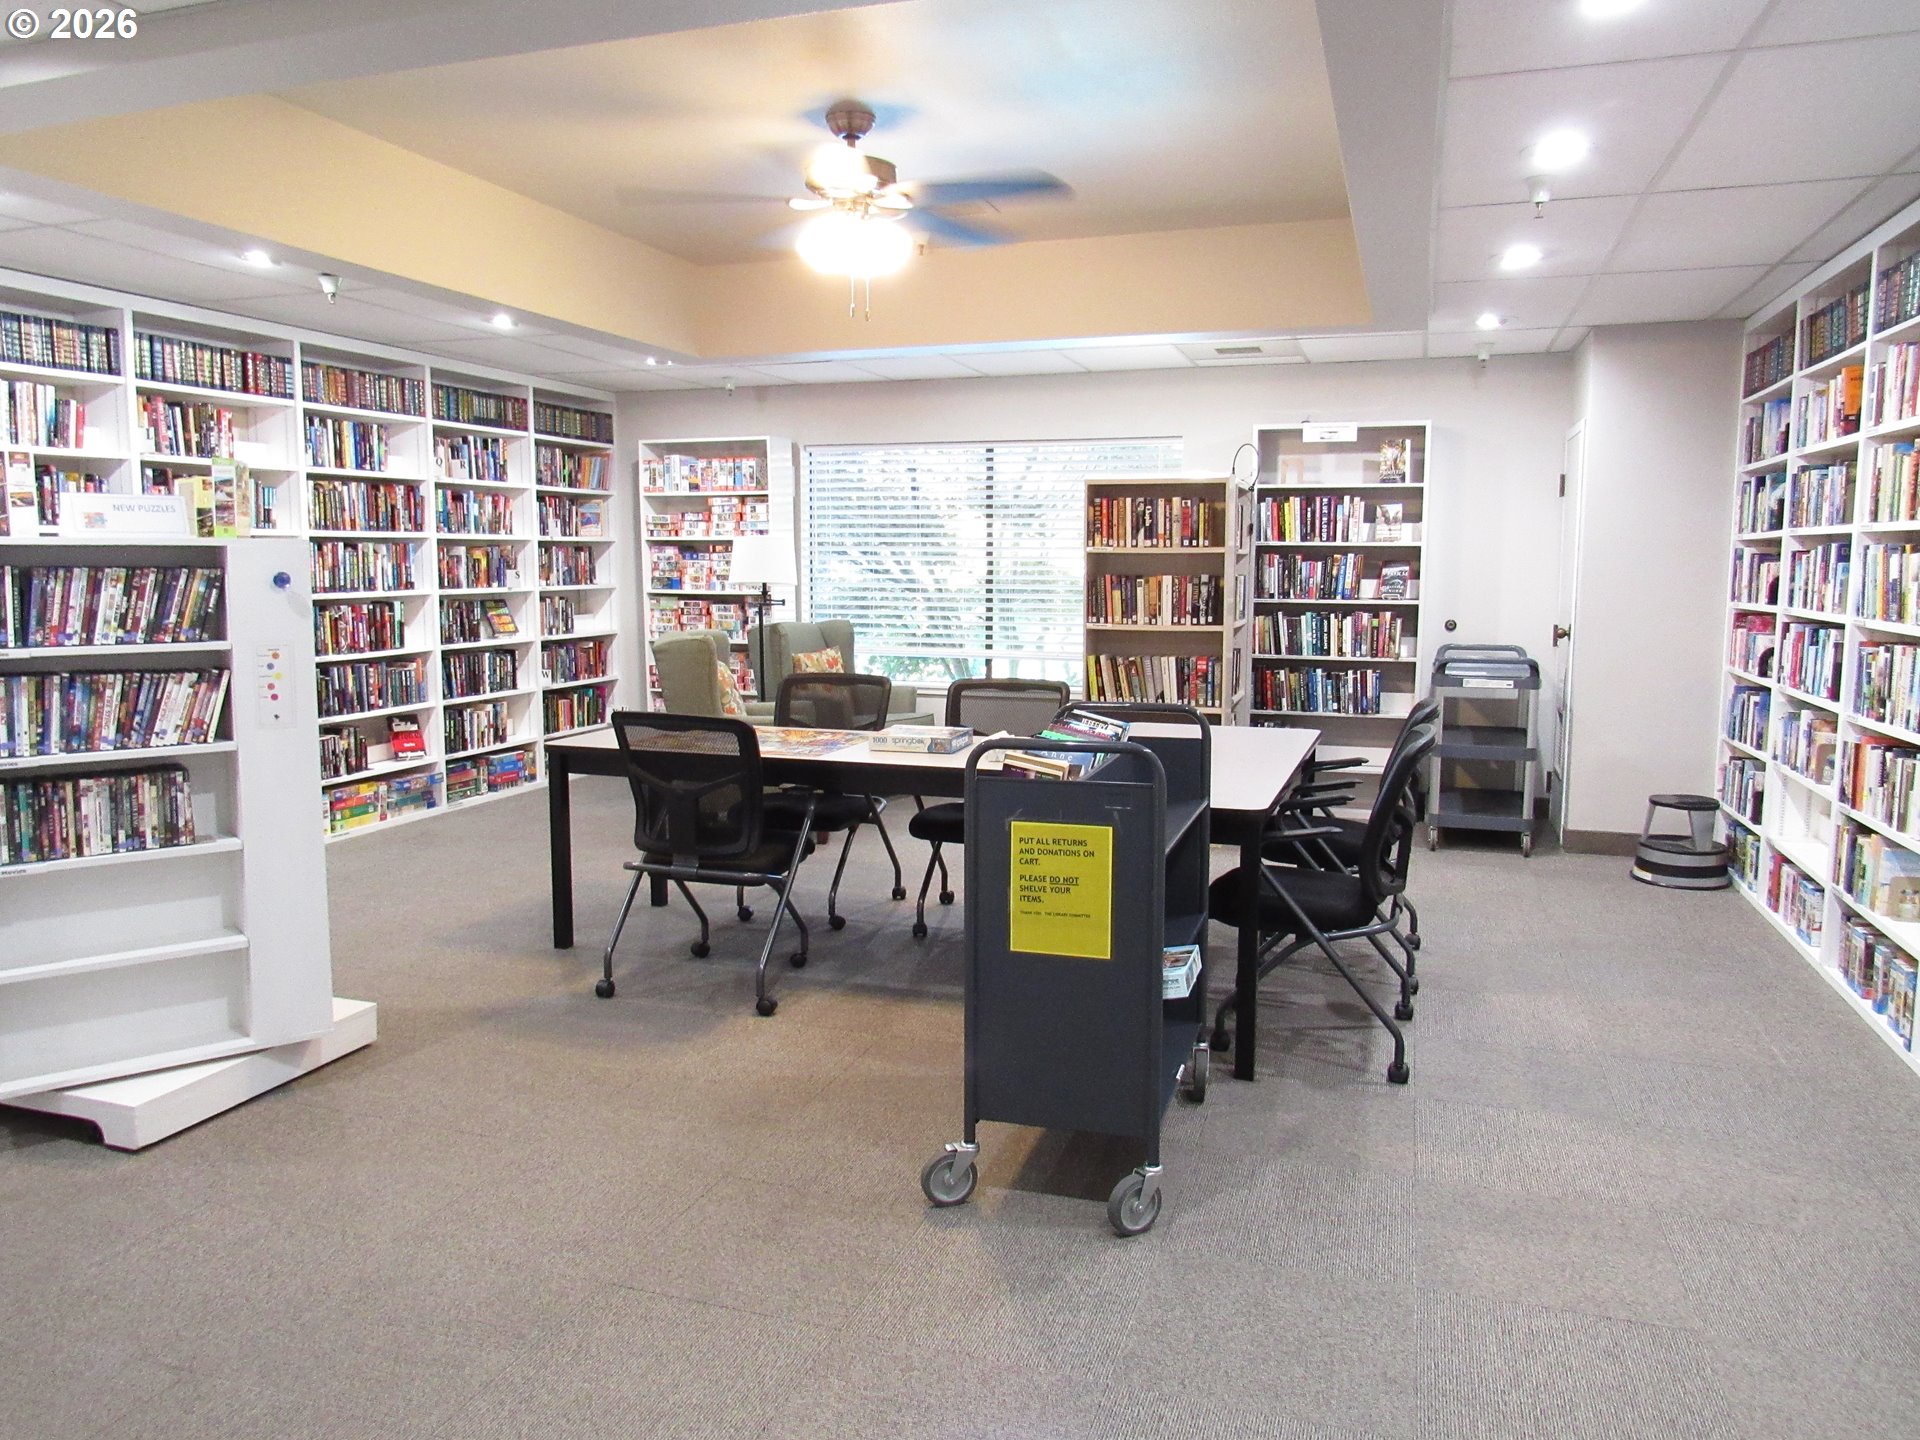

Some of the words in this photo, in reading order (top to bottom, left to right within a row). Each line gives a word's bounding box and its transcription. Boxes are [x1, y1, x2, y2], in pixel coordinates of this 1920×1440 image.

[435, 457, 443, 468] Q
[460, 460, 466, 469] R
[112, 504, 135, 512] NEW
[138, 505, 176, 513] PUZZLES
[515, 571, 520, 579] S
[892, 737, 925, 746] springbok
[1019, 837, 1034, 845] PUT
[1036, 837, 1050, 845] ALL
[1052, 838, 1088, 847] RETURNS
[1037, 848, 1081, 857] DONATIONS
[1019, 858, 1041, 866] CART.
[1019, 874, 1047, 883] PLEASE
[1050, 876, 1061, 884] DO
[1062, 876, 1079, 885] NOT
[1019, 885, 1047, 893] SHELVE
[1049, 885, 1071, 894] YOUR
[1019, 895, 1044, 903] ITEMS.
